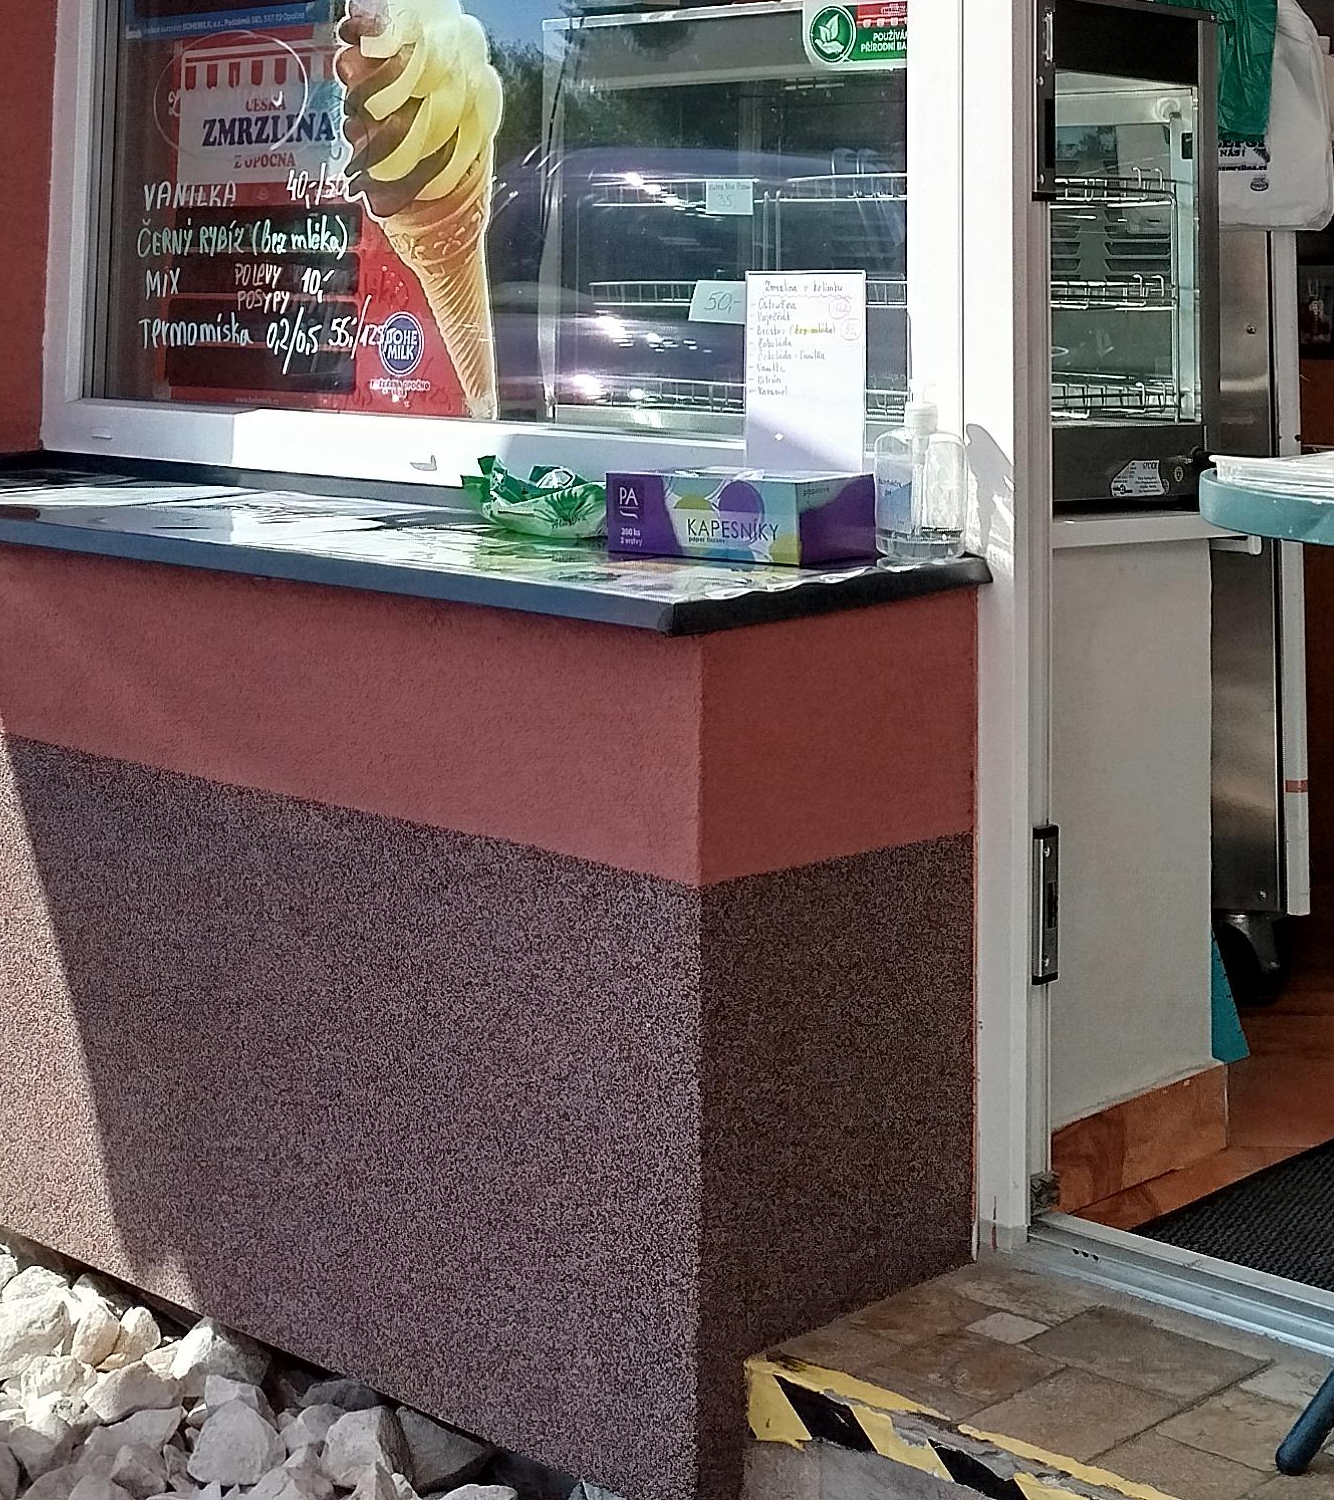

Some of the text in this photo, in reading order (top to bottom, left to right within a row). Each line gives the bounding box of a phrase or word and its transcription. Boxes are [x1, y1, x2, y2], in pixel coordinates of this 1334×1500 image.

[202, 111, 335, 148] ZMRZLINA
[144, 181, 237, 211] VANILKA
[237, 289, 291, 315] POSYPY
[387, 345, 415, 360] MILK
[619, 486, 639, 507] PA
[687, 518, 780, 542] KAPESNÍKY
